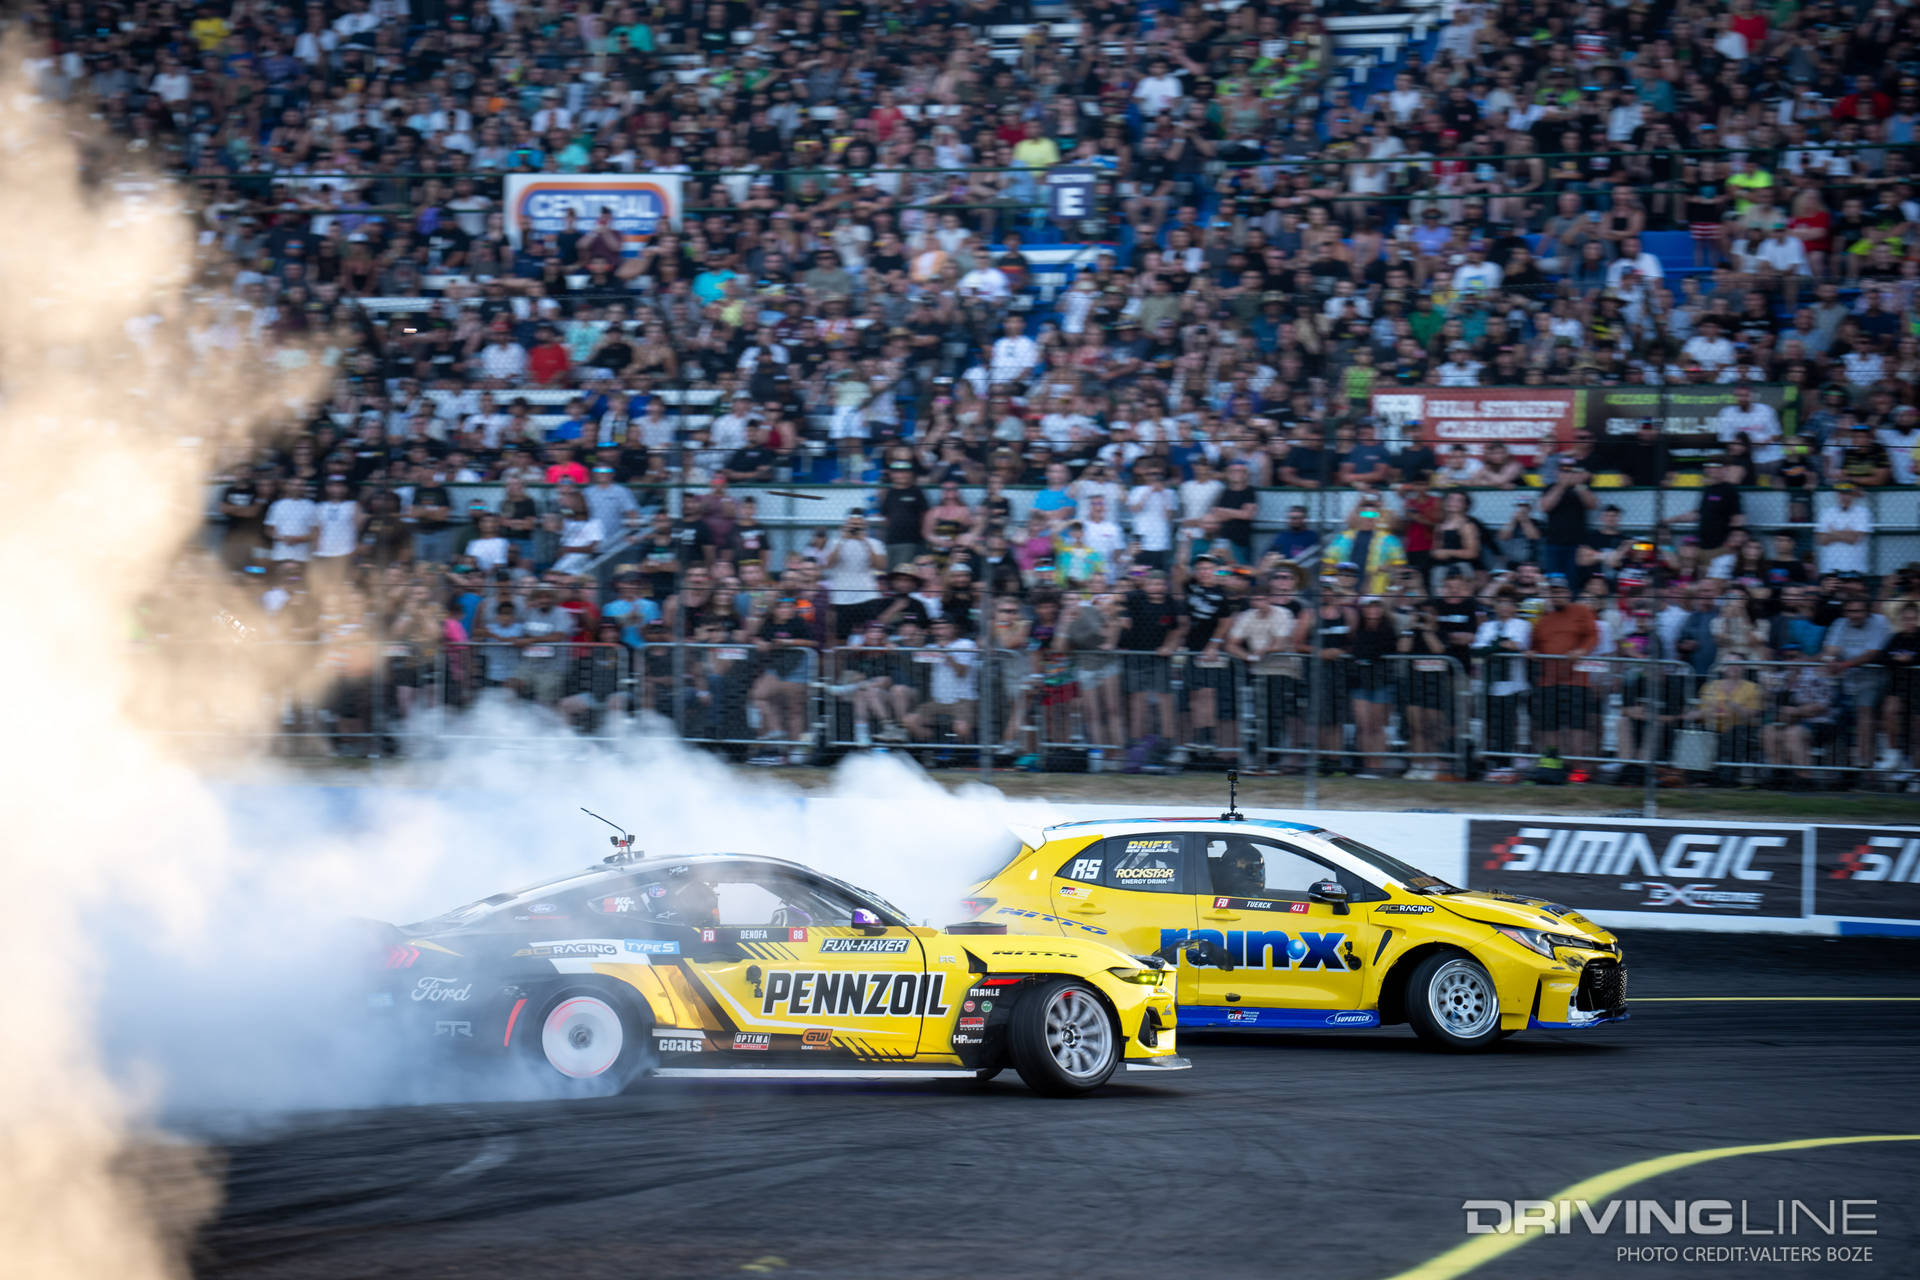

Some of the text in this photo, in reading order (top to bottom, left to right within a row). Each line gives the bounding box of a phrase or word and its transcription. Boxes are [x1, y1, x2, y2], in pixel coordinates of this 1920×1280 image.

[1058, 187, 1085, 216] E
[1127, 841, 1172, 849] DRIFT
[1503, 828, 1788, 881] SIMAGIC
[1115, 868, 1174, 878] ROCKSTAR
[1216, 898, 1305, 912] FD TUERCK 411
[996, 907, 1108, 935] NITTO
[703, 930, 714, 941] FD
[740, 930, 768, 940] DENOFA
[823, 939, 907, 952] FUN-HAVER
[411, 976, 472, 1001] Ford
[760, 970, 952, 1018] PENNZOIL
[970, 988, 1000, 997] MAHLE
[1337, 1013, 1370, 1023] SUPERTECH
[735, 1034, 769, 1044] OPTIMA
